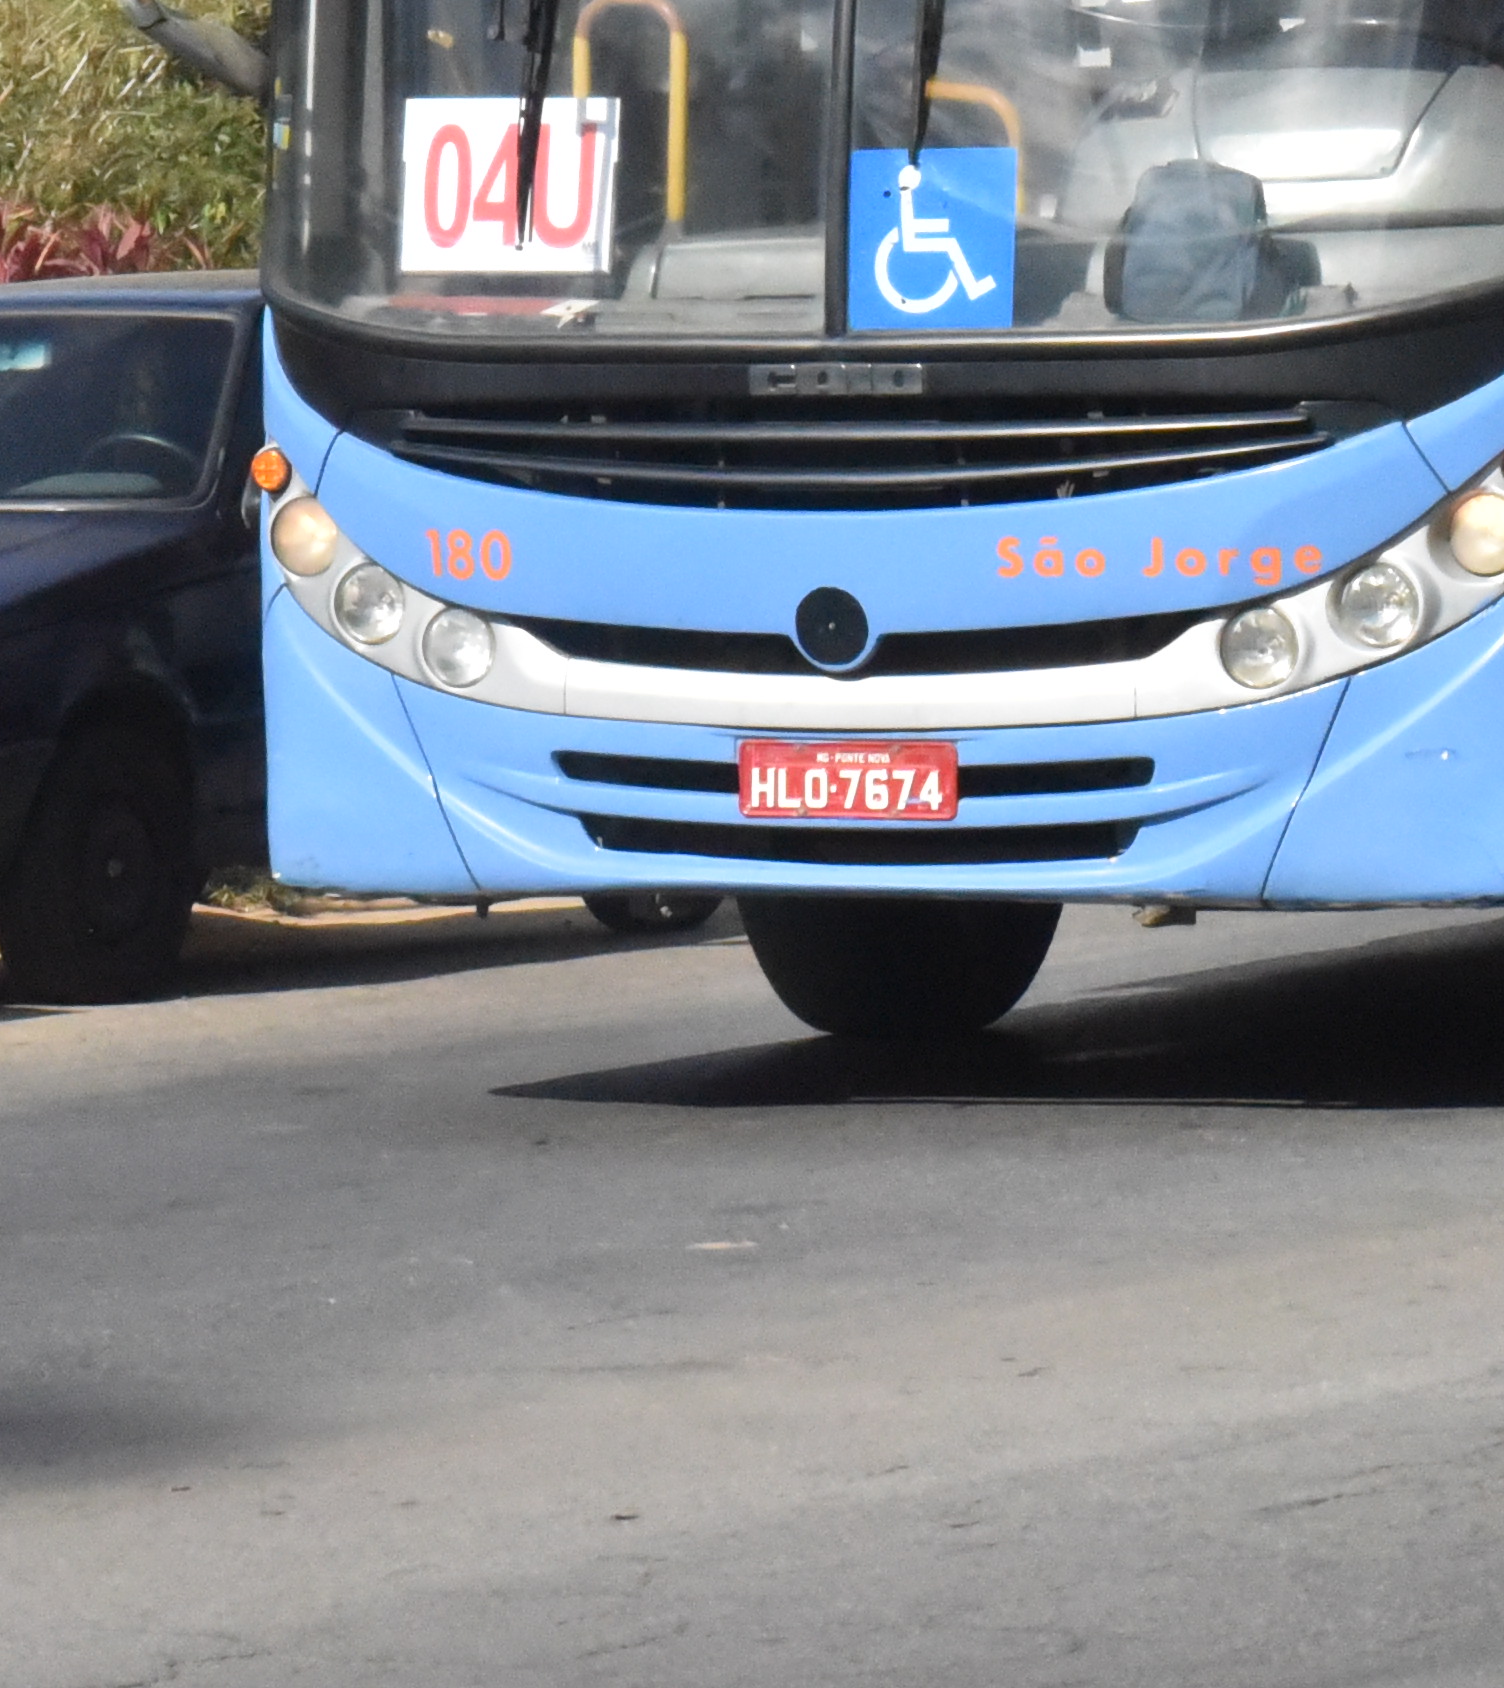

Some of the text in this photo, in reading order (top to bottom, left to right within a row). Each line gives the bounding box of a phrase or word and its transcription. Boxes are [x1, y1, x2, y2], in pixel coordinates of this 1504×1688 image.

[423, 123, 595, 250] 04U
[424, 528, 513, 582] 180
[997, 536, 1323, 586] São Jorge
